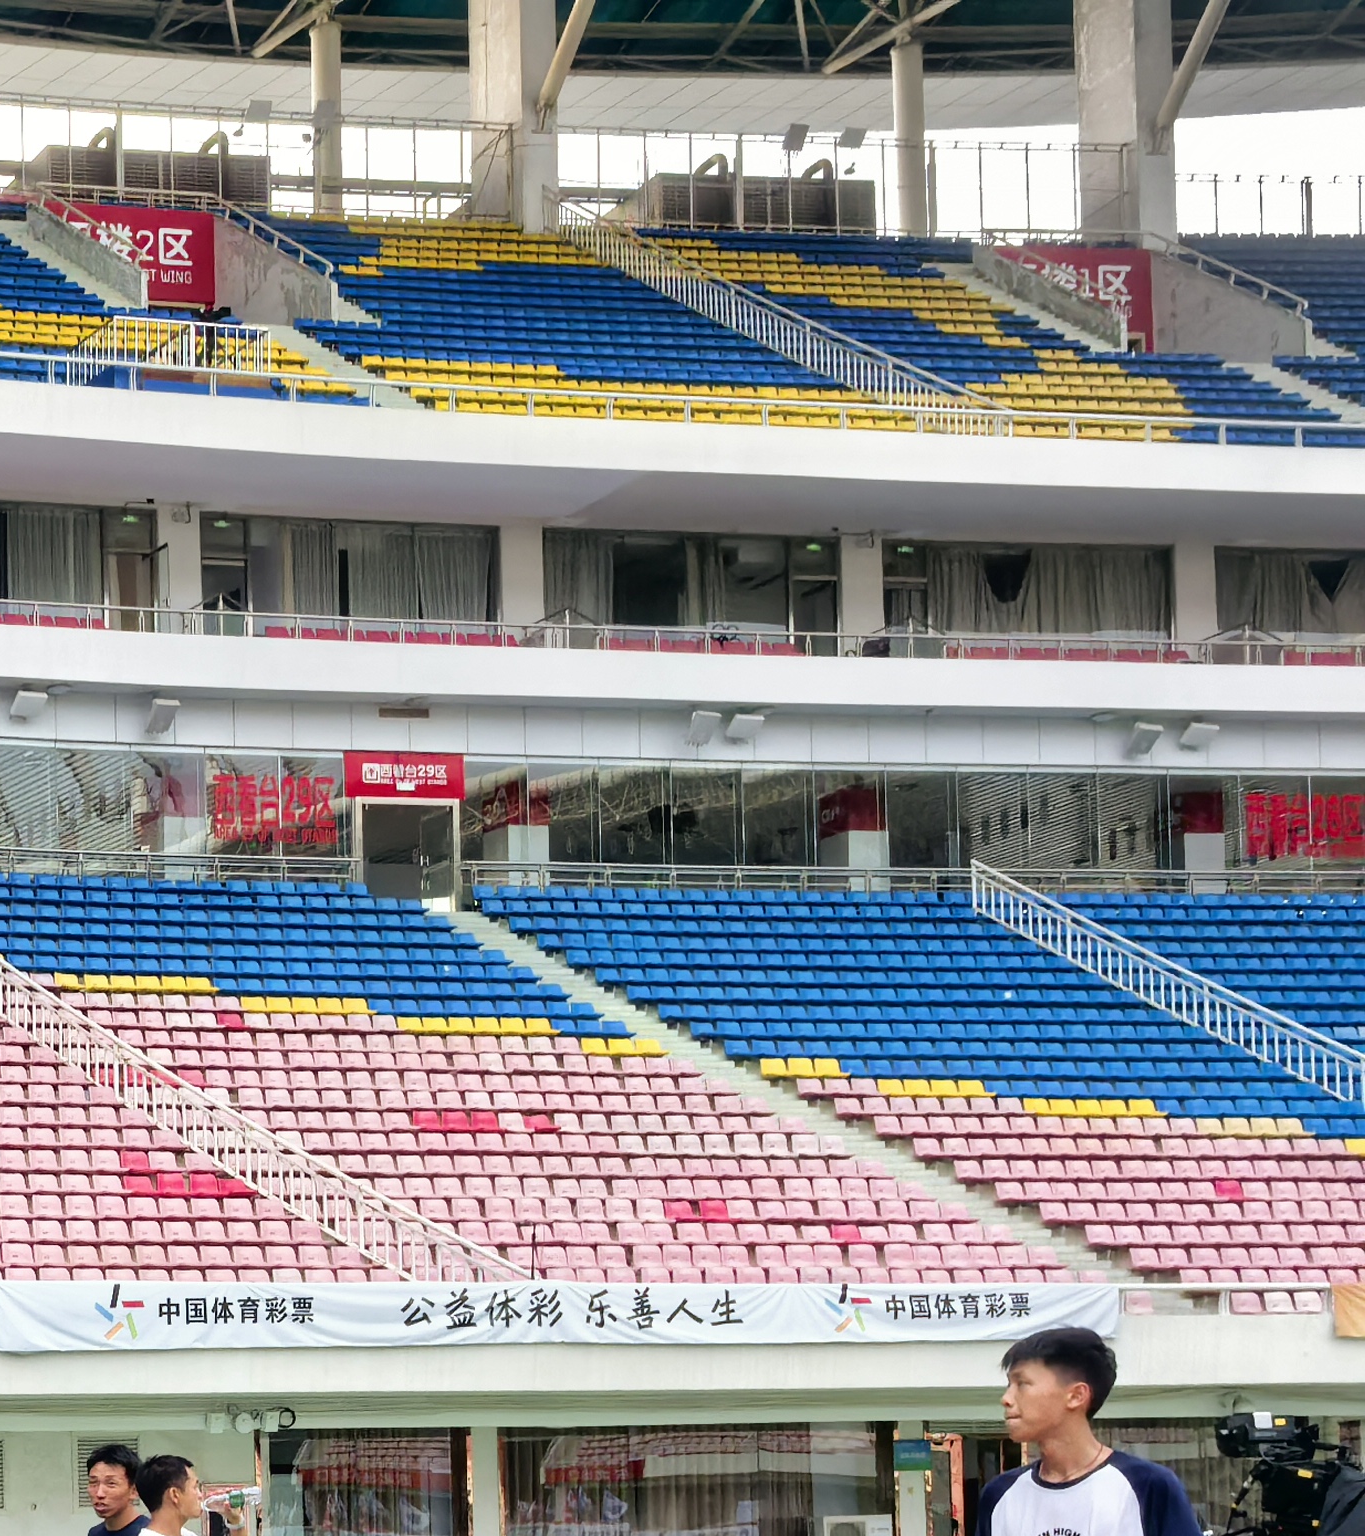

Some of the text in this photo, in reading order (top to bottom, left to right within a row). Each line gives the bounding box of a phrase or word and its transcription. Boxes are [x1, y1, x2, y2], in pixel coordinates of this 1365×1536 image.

[160, 269, 193, 284] WING
[213, 773, 337, 828] 西看台29区
[158, 1296, 315, 1326] 中国体育彩票
[400, 1287, 745, 1331] 公益体彩 乐善人生
[885, 1291, 1032, 1321] 中国体育彩票
